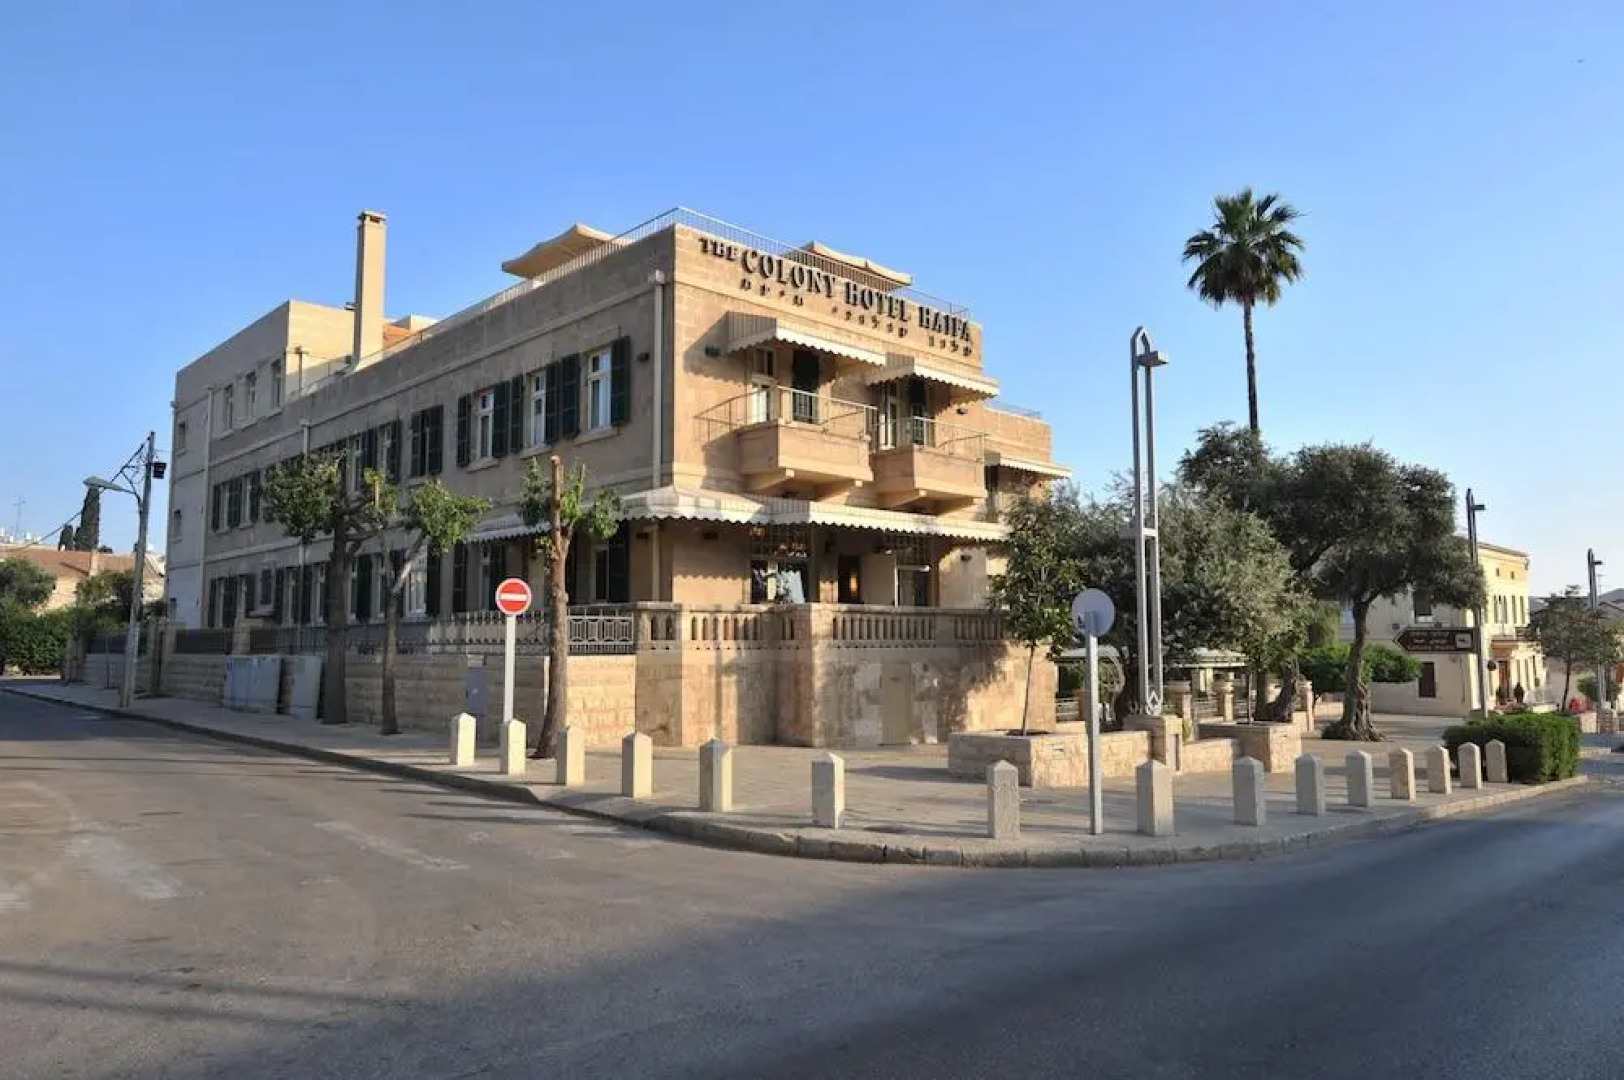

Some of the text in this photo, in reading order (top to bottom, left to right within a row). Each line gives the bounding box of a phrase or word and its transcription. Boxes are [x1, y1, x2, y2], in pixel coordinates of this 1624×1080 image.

[697, 237, 971, 341] THE COLONY HOTEL HAIFA
